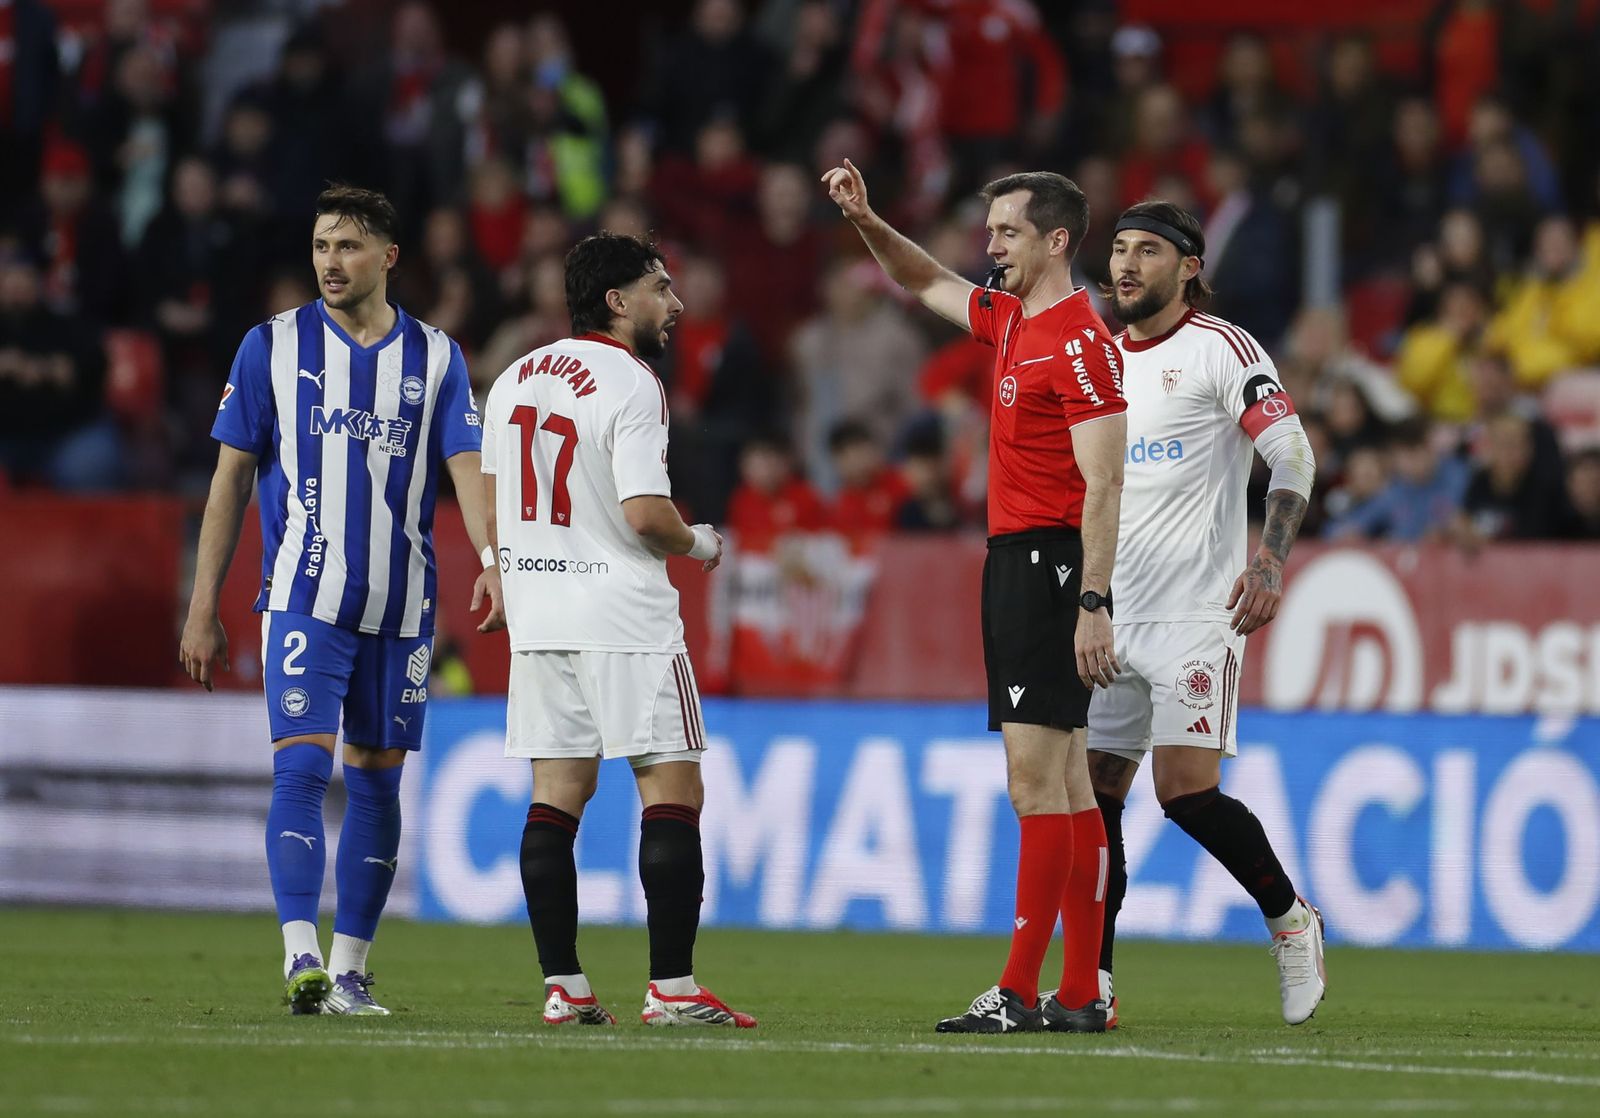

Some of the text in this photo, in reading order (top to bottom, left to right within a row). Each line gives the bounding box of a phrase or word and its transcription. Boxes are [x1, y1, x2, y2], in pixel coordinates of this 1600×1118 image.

[517, 354, 598, 399] MAUPAY
[1071, 357, 1105, 407] WÜRTH
[378, 444, 407, 457] NEWS
[508, 404, 579, 528] 17
[305, 533, 325, 577] araba
[283, 630, 308, 676] 2
[1181, 660, 1217, 673] JUICE TIME
[1431, 619, 1600, 715] JDS
